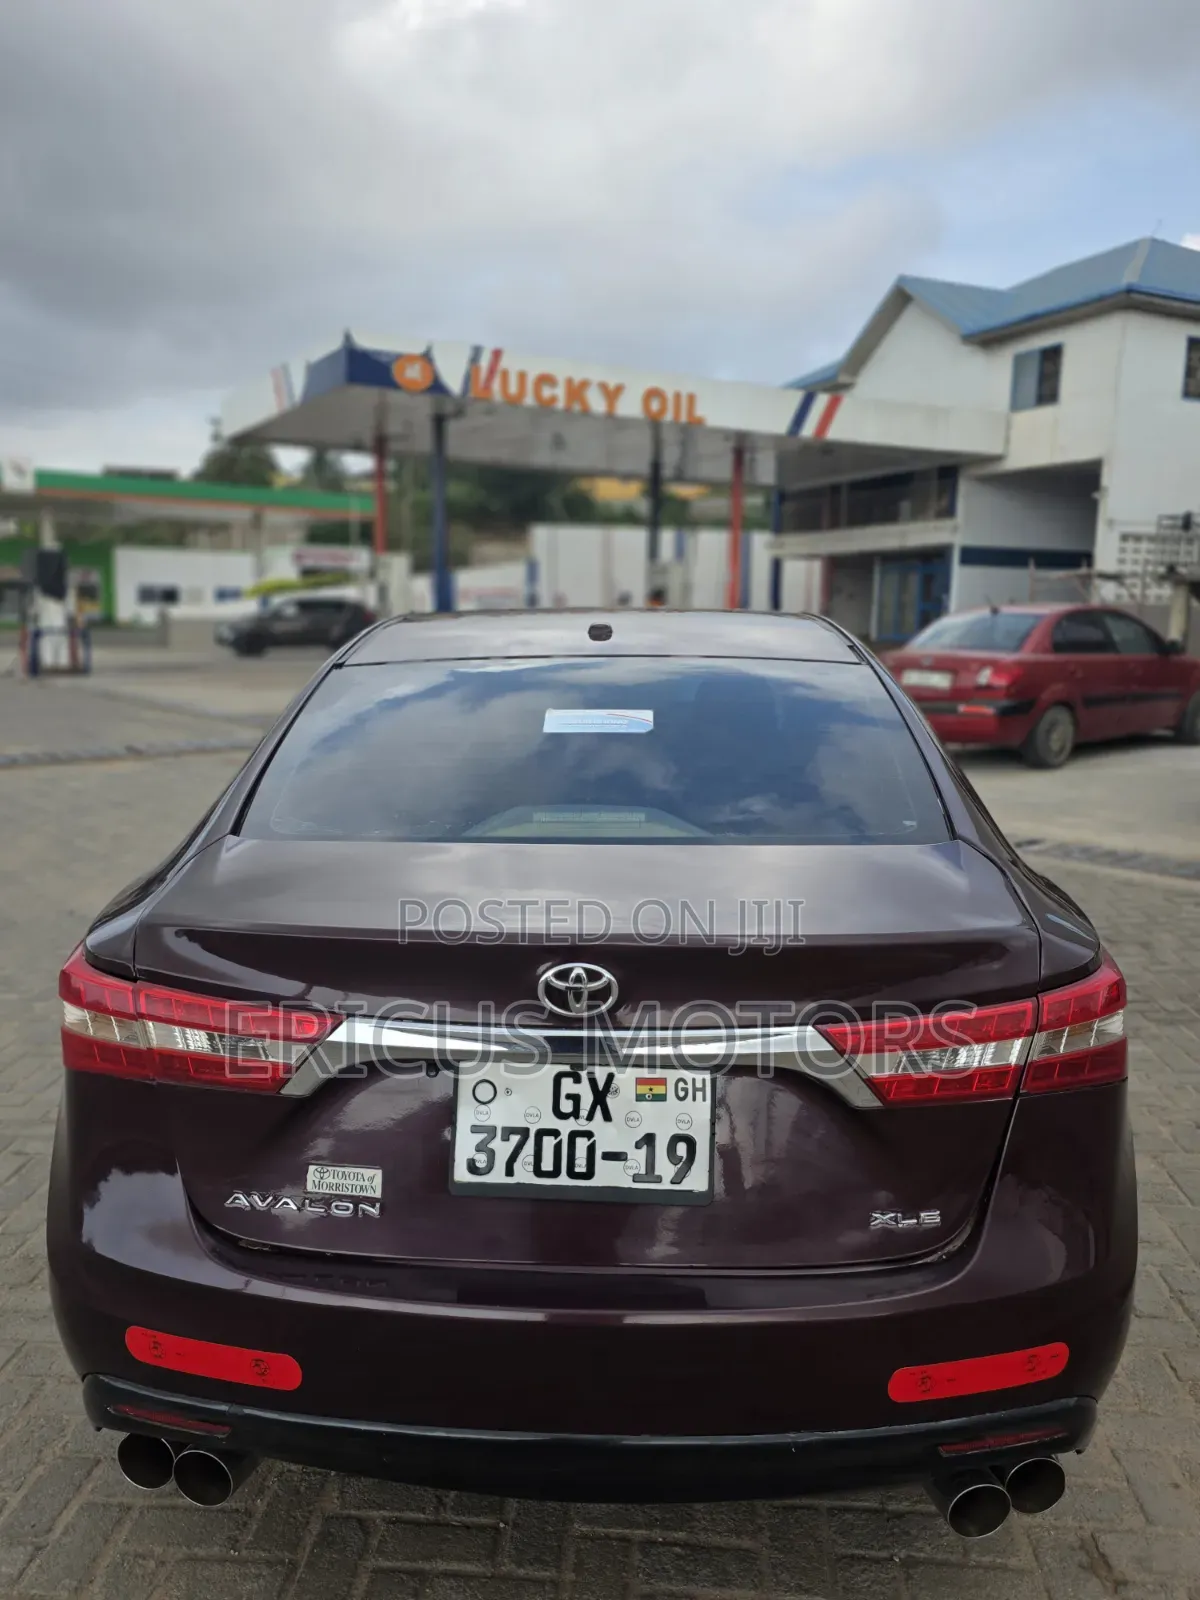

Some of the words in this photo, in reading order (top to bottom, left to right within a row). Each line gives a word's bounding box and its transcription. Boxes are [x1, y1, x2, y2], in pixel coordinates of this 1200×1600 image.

[470, 364, 625, 417] LUCKY
[641, 386, 706, 425] OIL
[552, 1070, 615, 1122] GX
[674, 1077, 707, 1102] GH
[466, 1125, 697, 1184] 3700-19
[311, 1179, 377, 1195] MORRISTOWN
[331, 1169, 365, 1182] TOYOTA
[366, 1173, 377, 1184] of
[224, 1192, 381, 1218] AVALON
